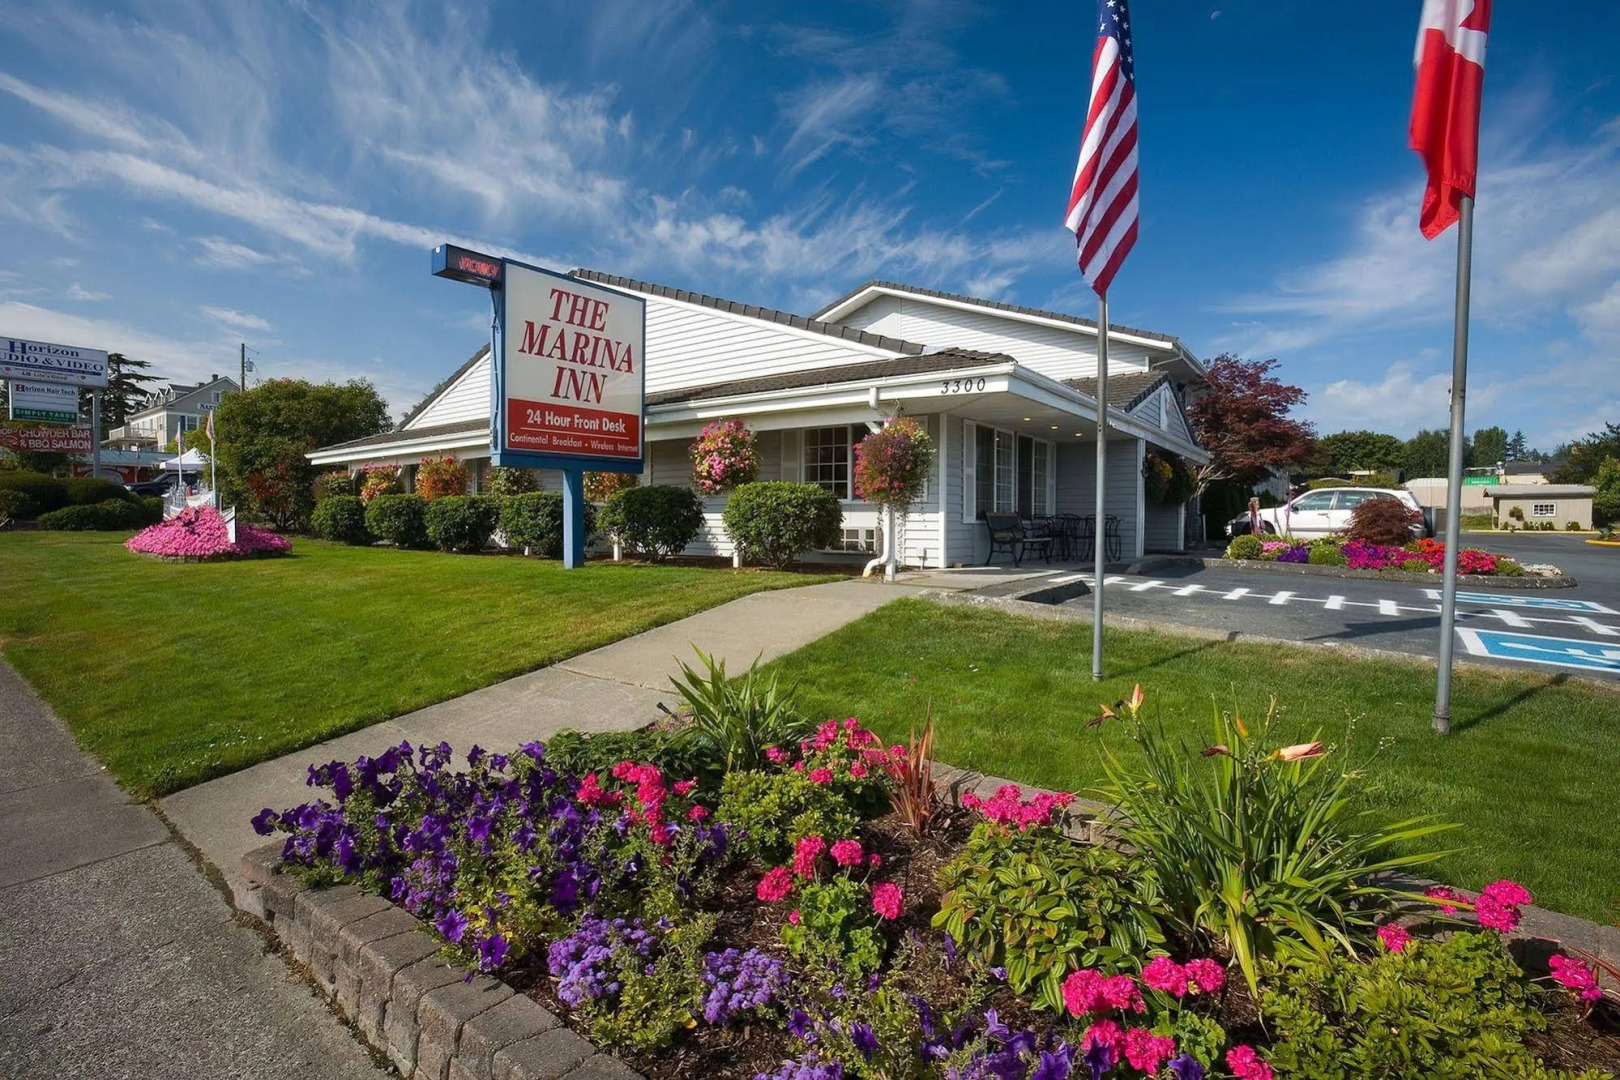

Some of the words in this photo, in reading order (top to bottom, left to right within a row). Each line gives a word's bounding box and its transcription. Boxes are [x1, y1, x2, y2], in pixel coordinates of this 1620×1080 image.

[549, 288, 609, 332] THE
[8, 340, 80, 358] Horizon
[518, 320, 634, 374] MARINA
[42, 357, 55, 366] &
[55, 358, 104, 371] VIDEO
[15, 383, 46, 394] Horizon
[550, 365, 608, 404] INN
[941, 378, 986, 394] 3300
[15, 409, 47, 417] SIMPLY
[526, 408, 542, 425] 24
[545, 411, 572, 428] Hour
[574, 414, 600, 431] Front
[602, 418, 626, 434] Desk
[19, 428, 70, 439] CHOWDER
[71, 430, 91, 439] BAR
[20, 439, 28, 448] &
[28, 439, 50, 449] BBQ
[51, 441, 92, 450] SALMON
[510, 432, 549, 445] Continental
[552, 436, 582, 448] Breakfast
[590, 440, 615, 452] Wireless
[617, 442, 638, 453] Internet
